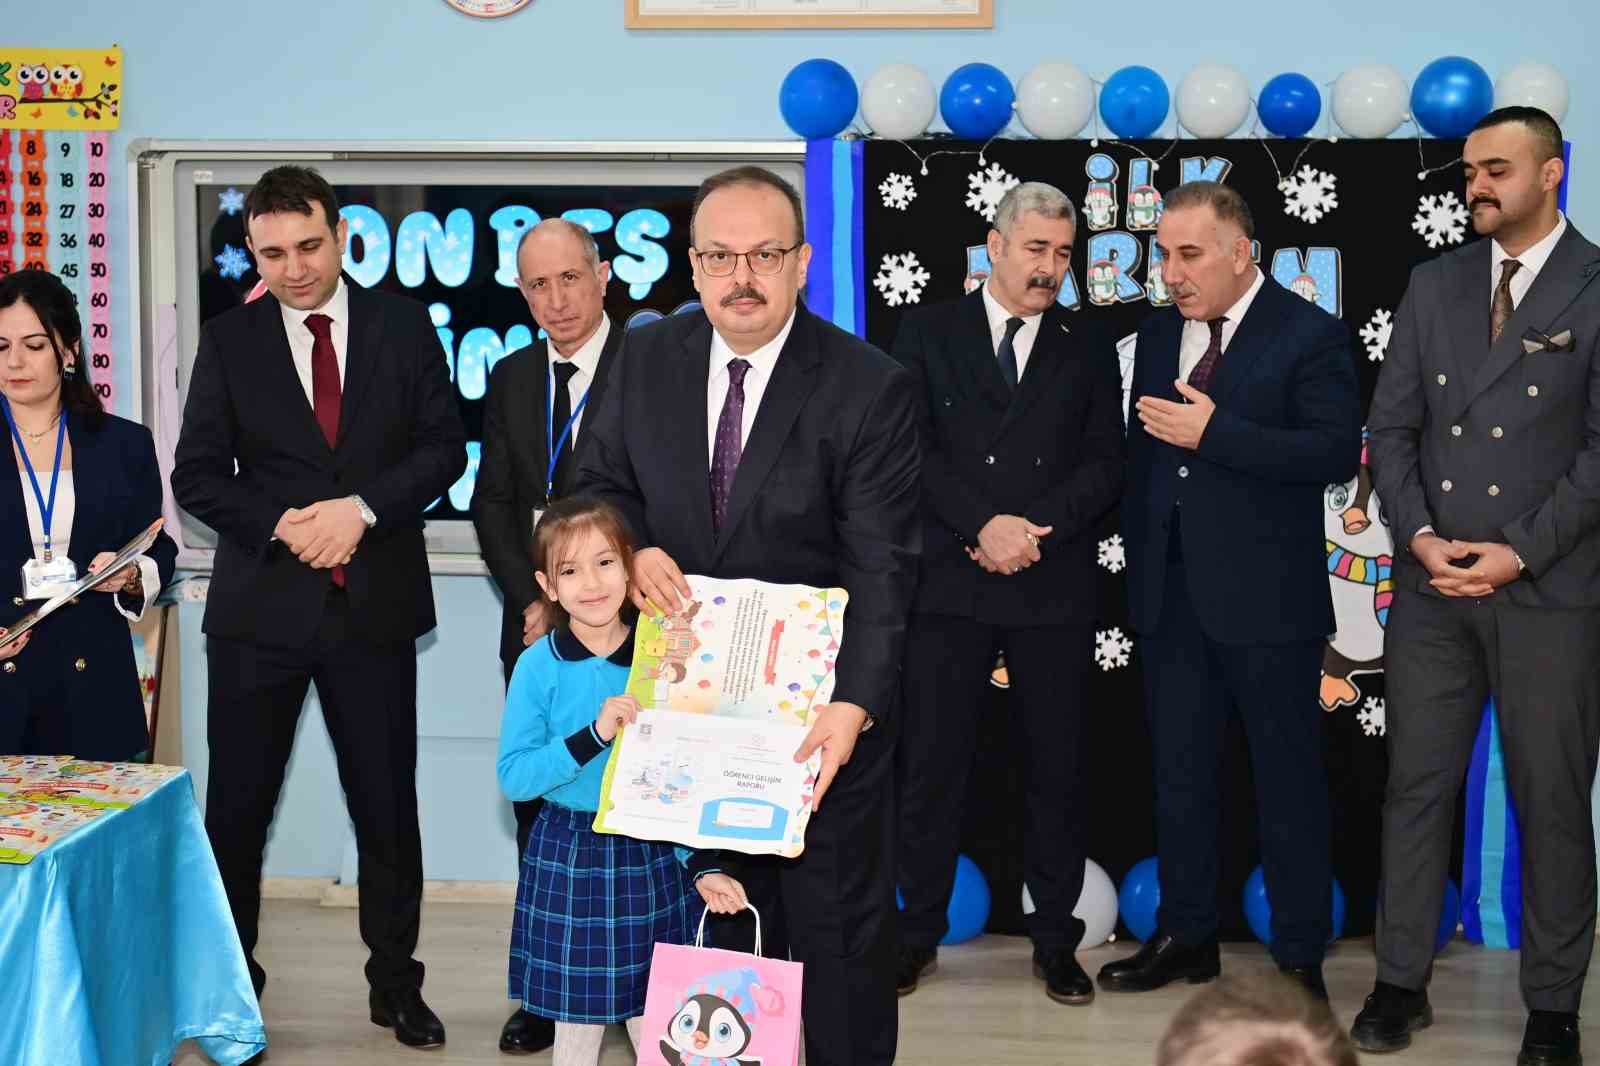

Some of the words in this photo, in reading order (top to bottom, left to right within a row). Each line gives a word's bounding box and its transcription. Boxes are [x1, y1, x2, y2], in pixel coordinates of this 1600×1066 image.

[27, 140, 36, 155] 8
[61, 142, 71, 157] 9
[91, 142, 103, 157] 10
[27, 171, 41, 186] 16
[60, 173, 74, 187] 18
[89, 173, 105, 187] 20
[25, 202, 42, 216] 24
[60, 204, 75, 219] 27
[88, 203, 105, 218] 30
[25, 232, 43, 247] 32
[60, 233, 77, 248] 36
[88, 233, 105, 248] 40
[60, 264, 78, 278] 45
[91, 263, 107, 277] 50
[91, 293, 108, 307] 60
[92, 323, 108, 338] 70
[93, 354, 110, 369] 80
[94, 383, 111, 398] 90
